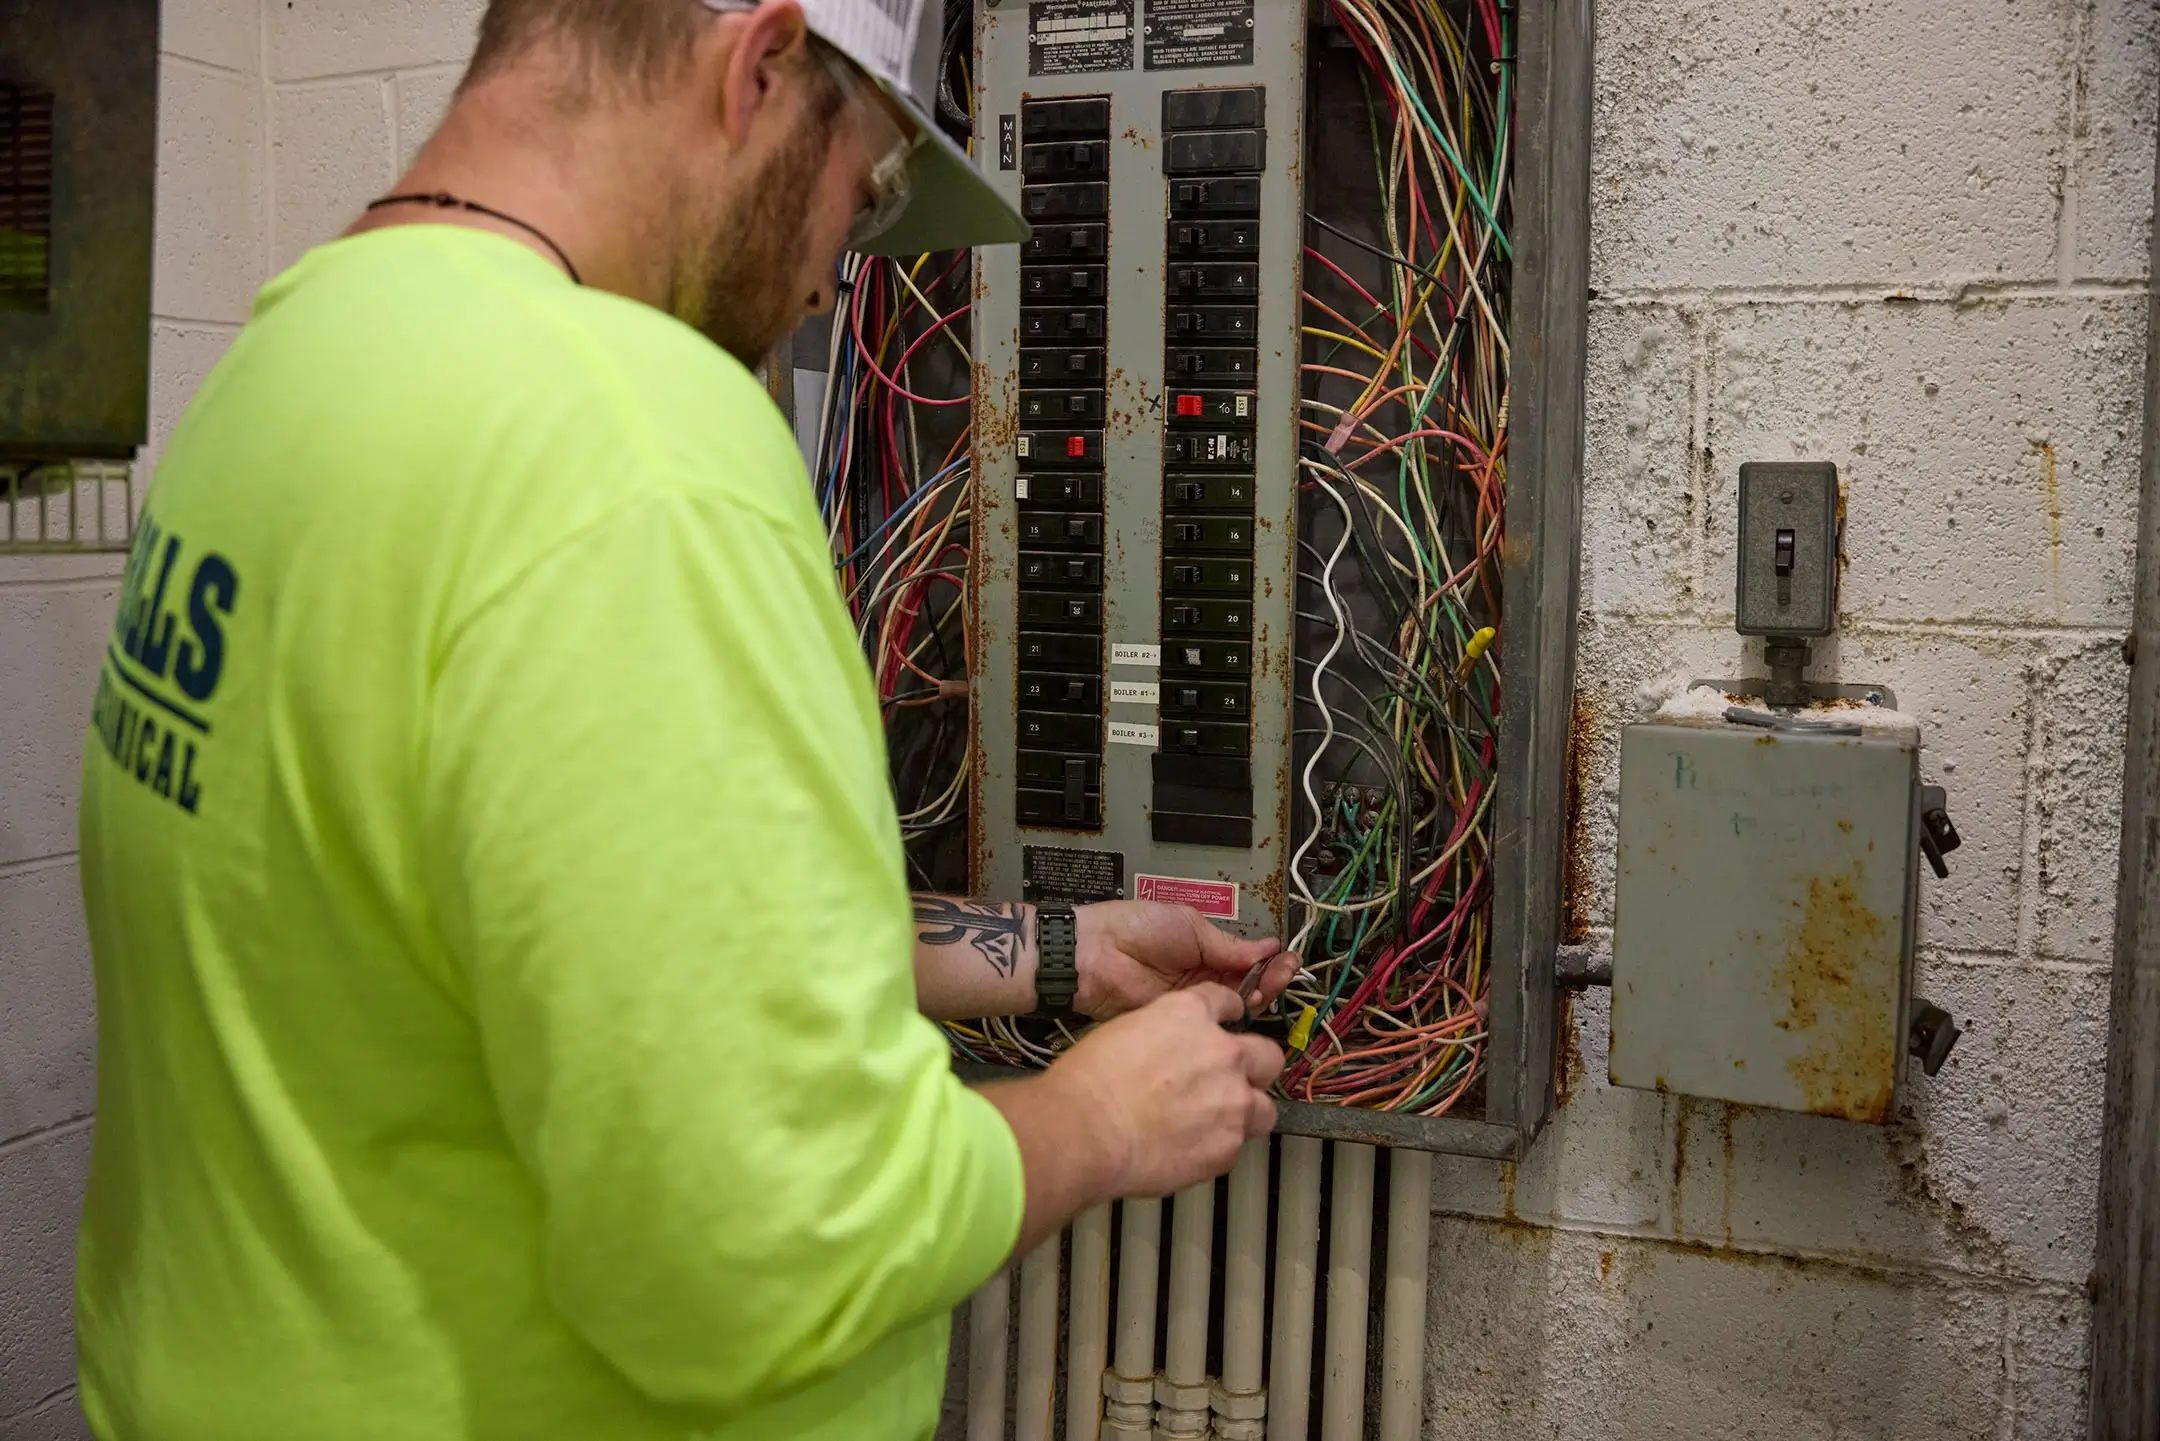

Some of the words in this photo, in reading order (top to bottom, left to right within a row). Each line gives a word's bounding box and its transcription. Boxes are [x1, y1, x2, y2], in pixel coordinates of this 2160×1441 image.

[1003, 121, 1013, 163] MAIN
[1237, 235, 1243, 244] 2
[1236, 275, 1243, 284] 4
[1035, 280, 1041, 289] 3
[1235, 320, 1241, 328] 6
[1032, 362, 1038, 370] 7
[1235, 362, 1241, 370] 8
[1030, 526, 1039, 534] 15
[1230, 531, 1240, 540] 16
[1029, 565, 1039, 573] 17
[1230, 573, 1240, 582] 18
[1227, 615, 1239, 623] 20
[1031, 645, 1039, 653] 21
[1114, 650, 1138, 659] BOILER
[1030, 685, 1040, 693] 23
[1113, 689, 1137, 697] BOILER
[1224, 697, 1235, 705] 24
[1029, 724, 1039, 732] 25
[1112, 729, 1136, 738] BOILER
